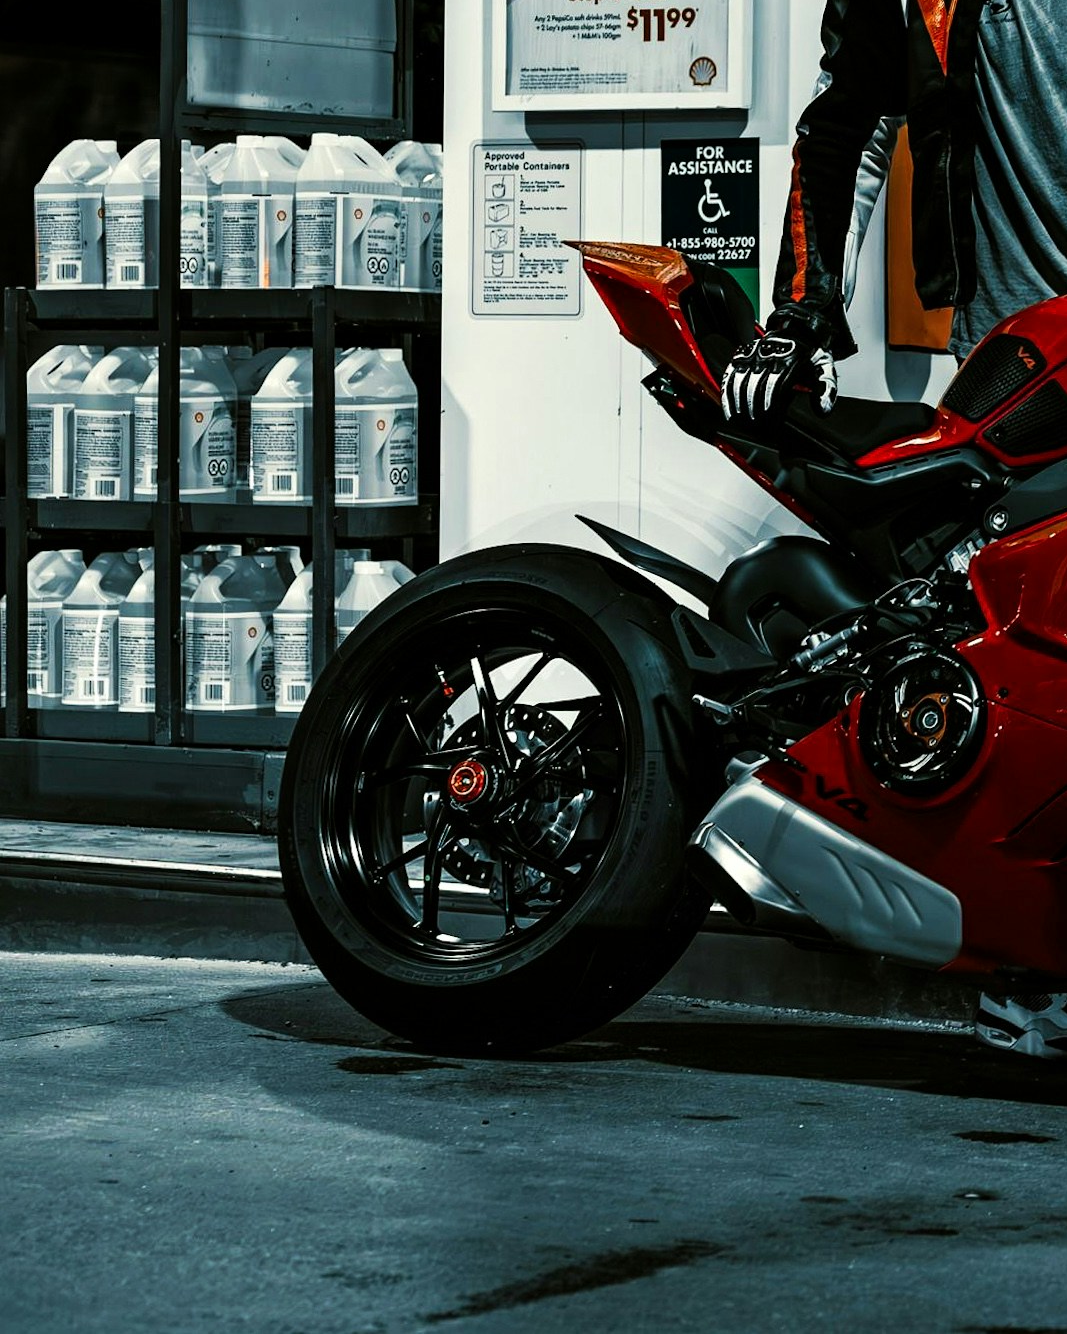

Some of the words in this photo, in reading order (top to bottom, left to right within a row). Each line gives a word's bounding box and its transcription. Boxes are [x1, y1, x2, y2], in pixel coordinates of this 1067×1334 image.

[534, 15, 546, 24] Any
[551, 14, 574, 24] PepsiCo
[541, 24, 546, 32] 2
[581, 24, 595, 32] chips
[484, 152, 525, 162] Approved
[696, 146, 724, 160] FOR
[484, 162, 520, 171] Portable
[523, 162, 570, 171] Containers
[668, 160, 753, 176] ASSISTANCE
[702, 227, 718, 235] CALL
[666, 236, 756, 249] +1-855-980-5700
[717, 249, 752, 260] 22627
[1018, 346, 1036, 370] V4
[816, 775, 870, 822] V4
